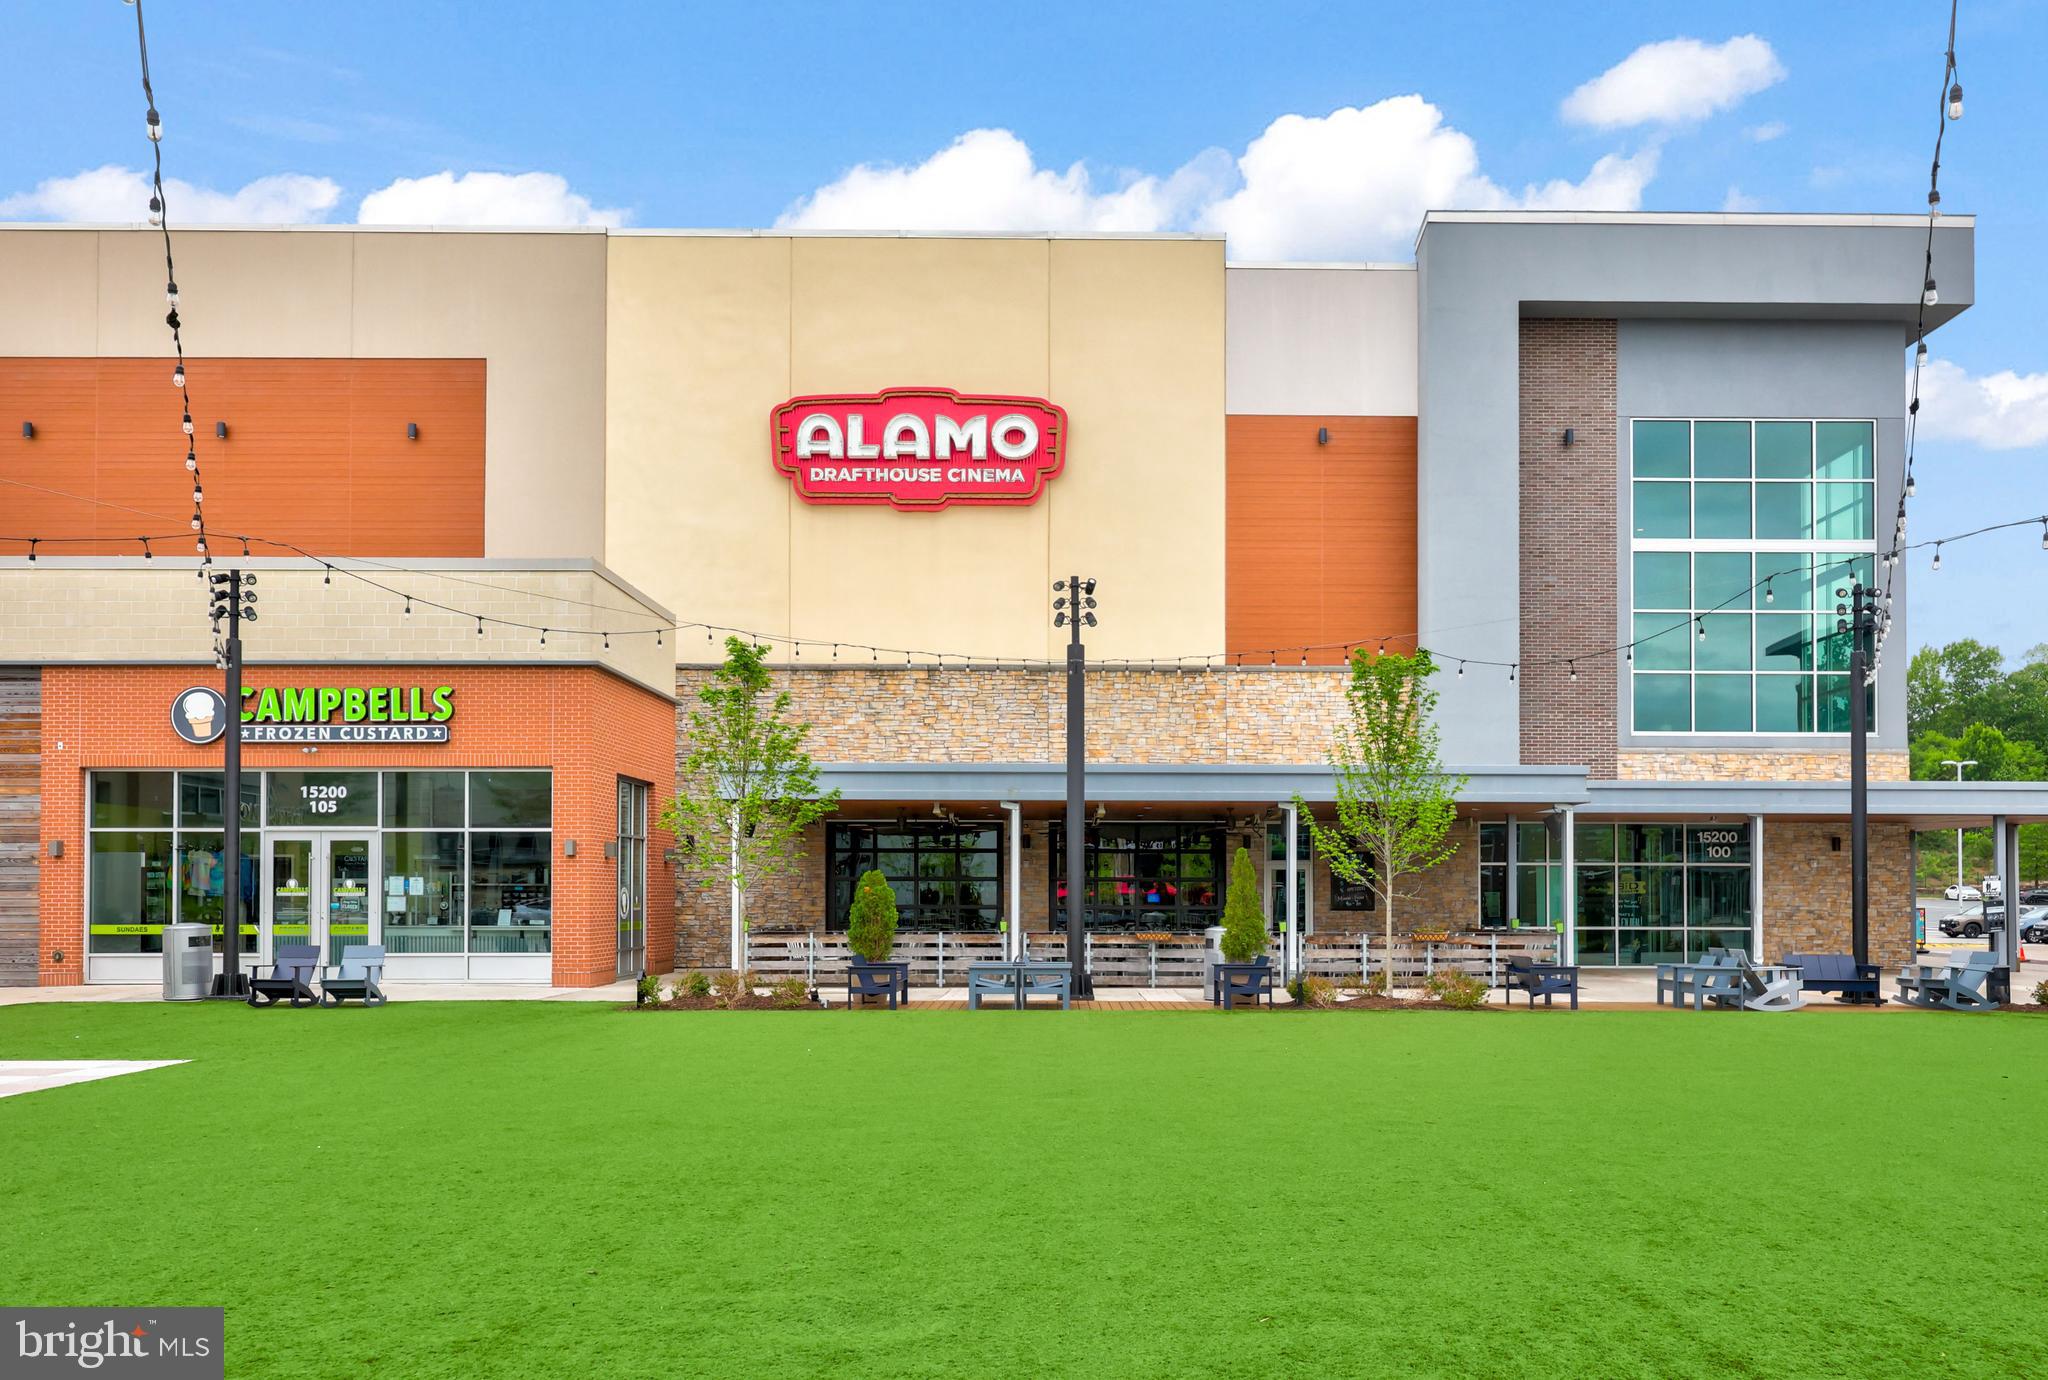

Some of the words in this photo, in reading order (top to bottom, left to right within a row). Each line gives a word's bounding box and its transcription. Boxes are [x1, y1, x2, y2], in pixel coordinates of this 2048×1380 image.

[796, 413, 1039, 460] ALAMO
[810, 467, 942, 482] DRAFTHOUSE
[947, 467, 1025, 482] CINEMA
[254, 727, 331, 741] FROZEN
[339, 727, 429, 741] CUSTARD
[300, 785, 348, 799] 15200
[309, 801, 337, 814] 105
[1697, 831, 1738, 844] 15200
[1706, 846, 1731, 858] 100
